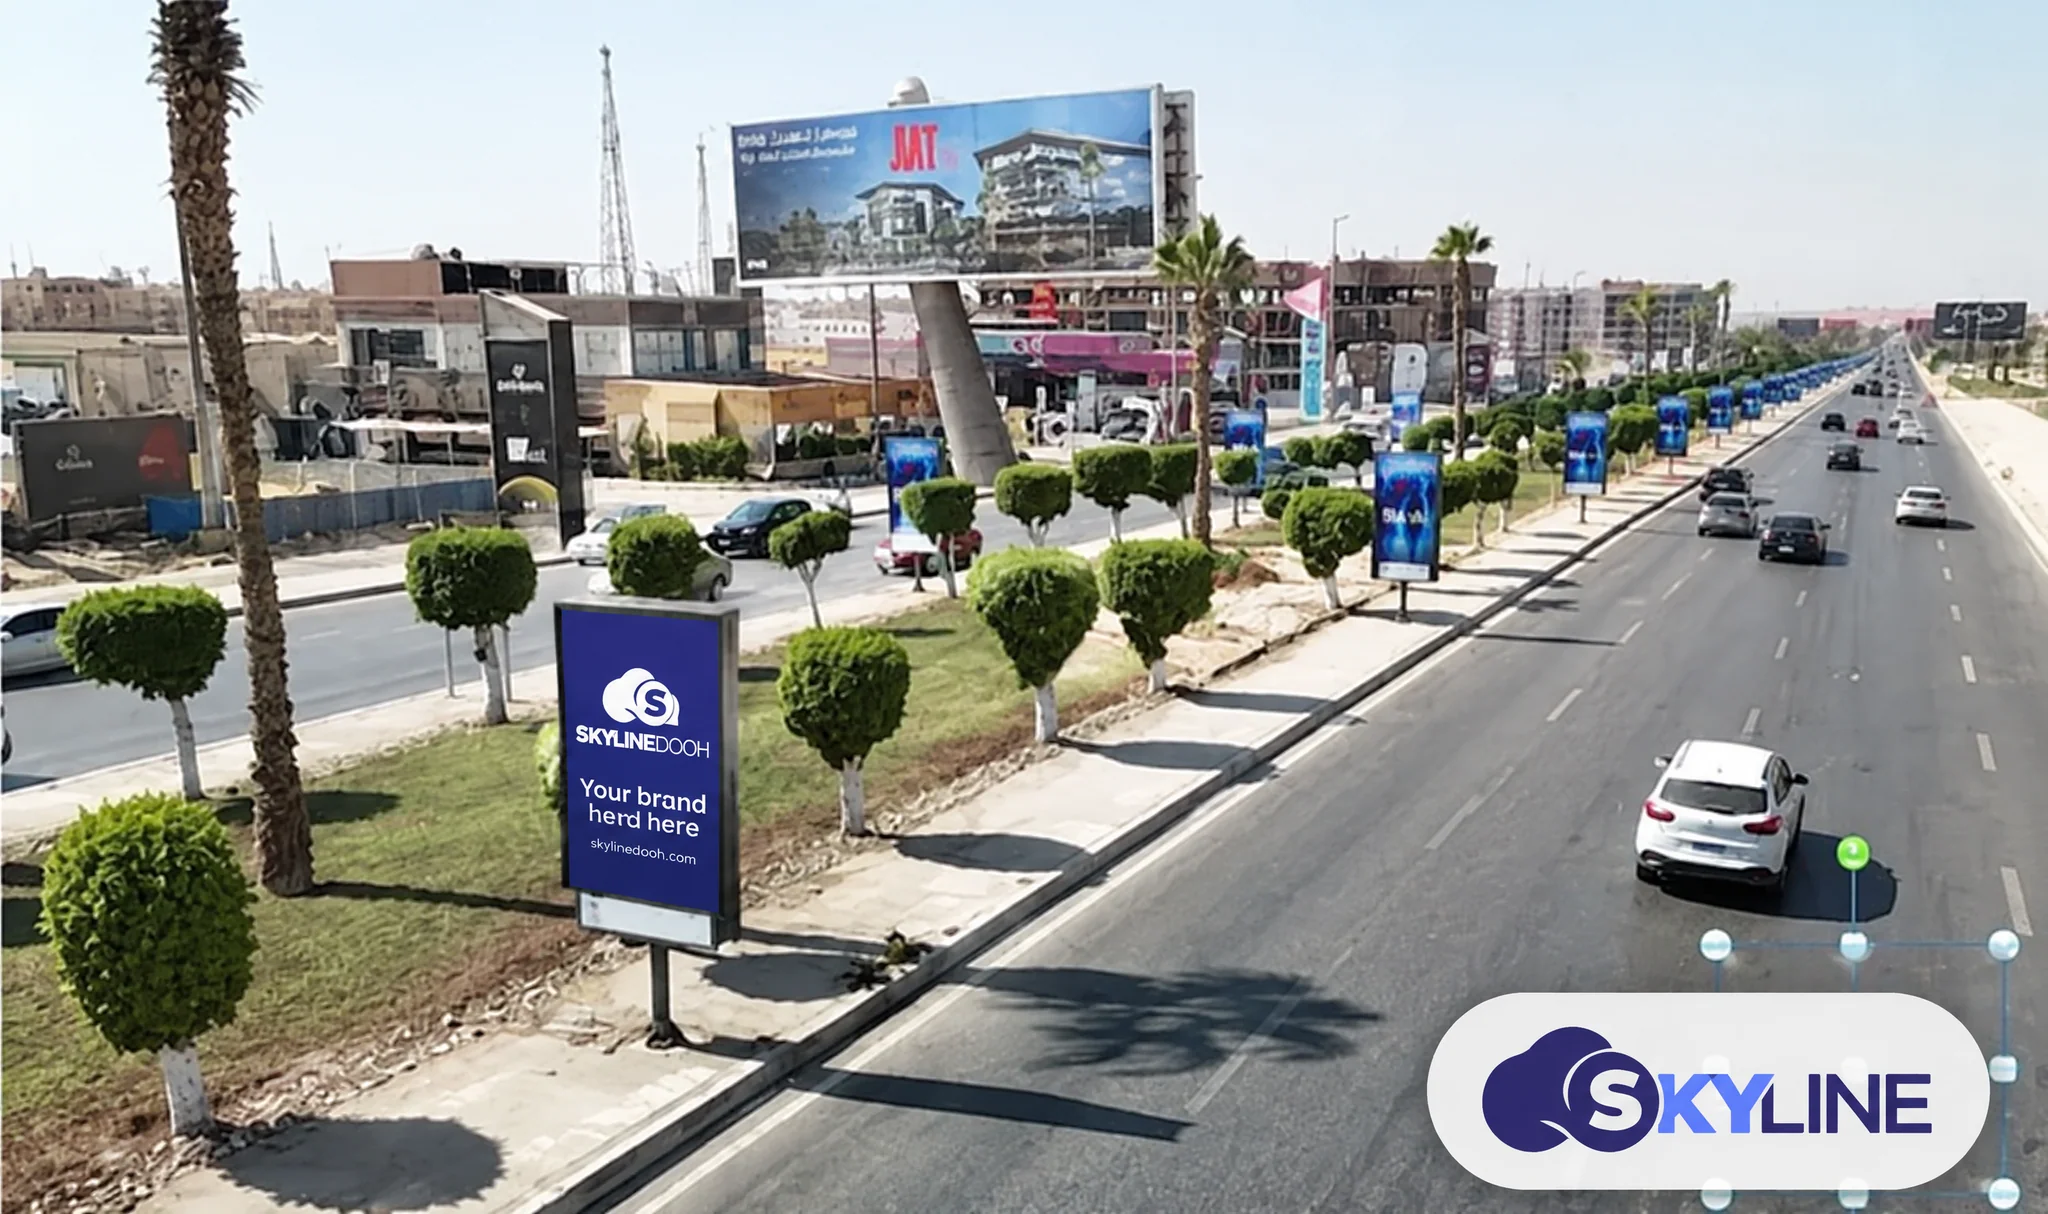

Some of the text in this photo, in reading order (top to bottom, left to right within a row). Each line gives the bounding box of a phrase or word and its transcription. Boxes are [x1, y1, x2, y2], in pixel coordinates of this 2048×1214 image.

[643, 688, 667, 718] S
[575, 724, 710, 759] SKYLINEDOOH
[579, 777, 706, 815] Your brand
[589, 802, 700, 837] herd here
[590, 837, 697, 865] skylinedooh.com
